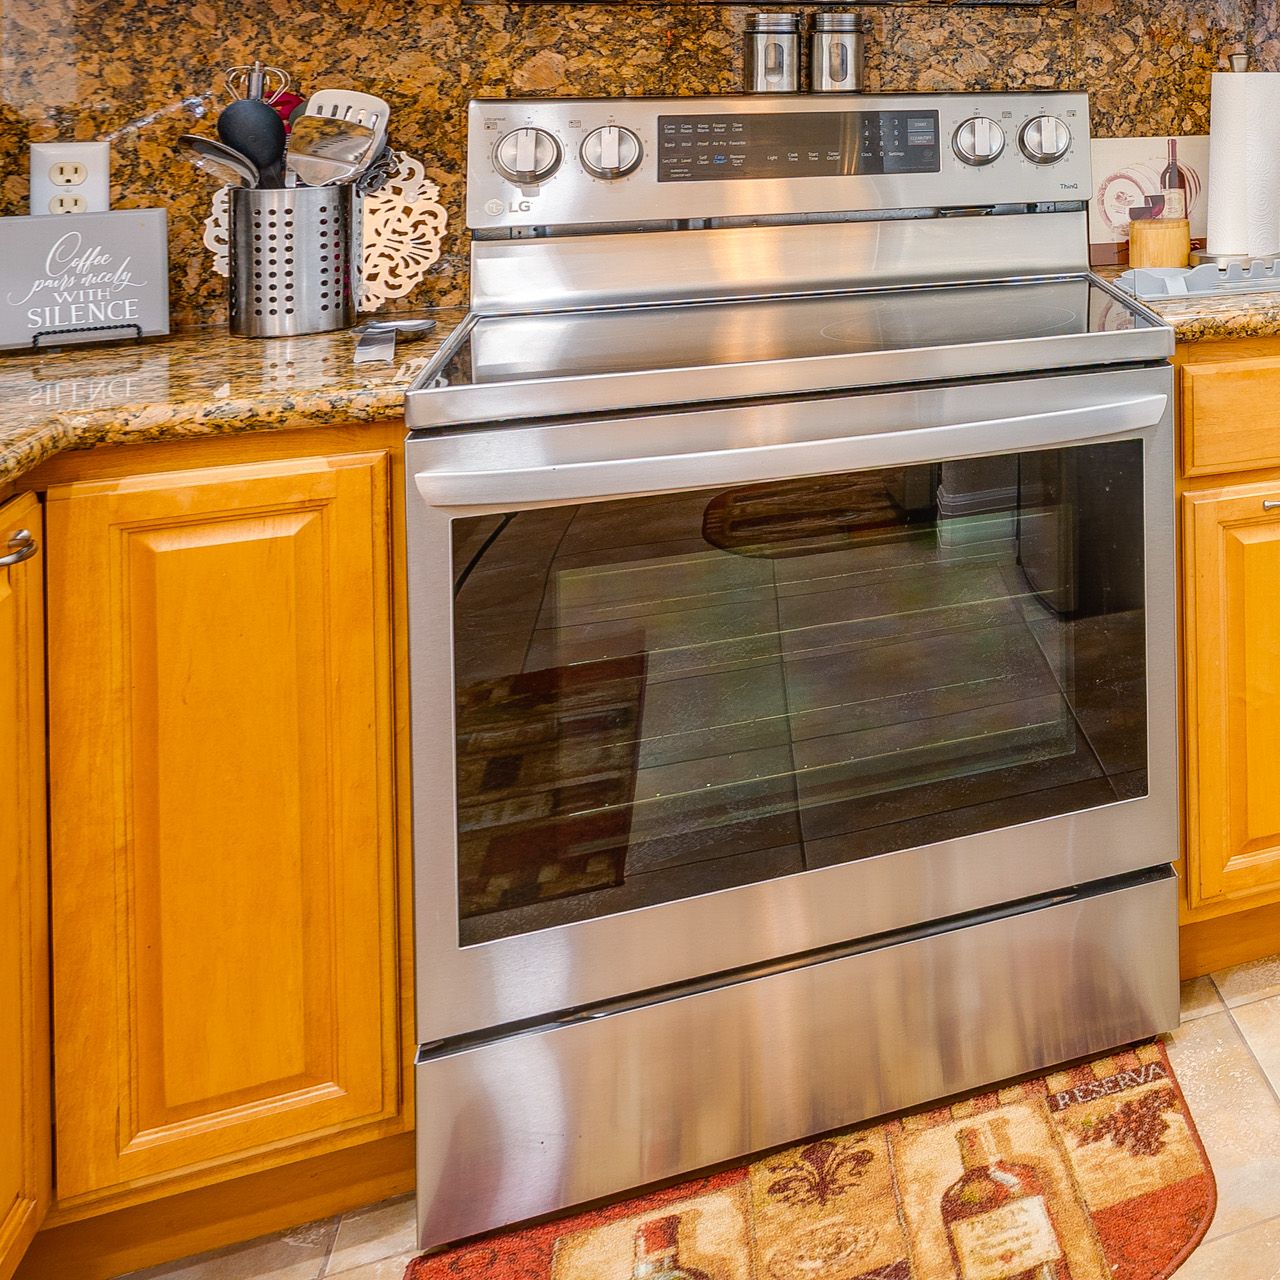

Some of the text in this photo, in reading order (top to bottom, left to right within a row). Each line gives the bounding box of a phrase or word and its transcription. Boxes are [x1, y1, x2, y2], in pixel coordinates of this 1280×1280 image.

[509, 201, 531, 213] LG
[46, 231, 113, 277] Coffee
[7, 256, 148, 306] pairs nicely
[52, 287, 111, 303] WITH
[27, 299, 140, 328] SILENCE
[1056, 1063, 1170, 1110] RESERVA
